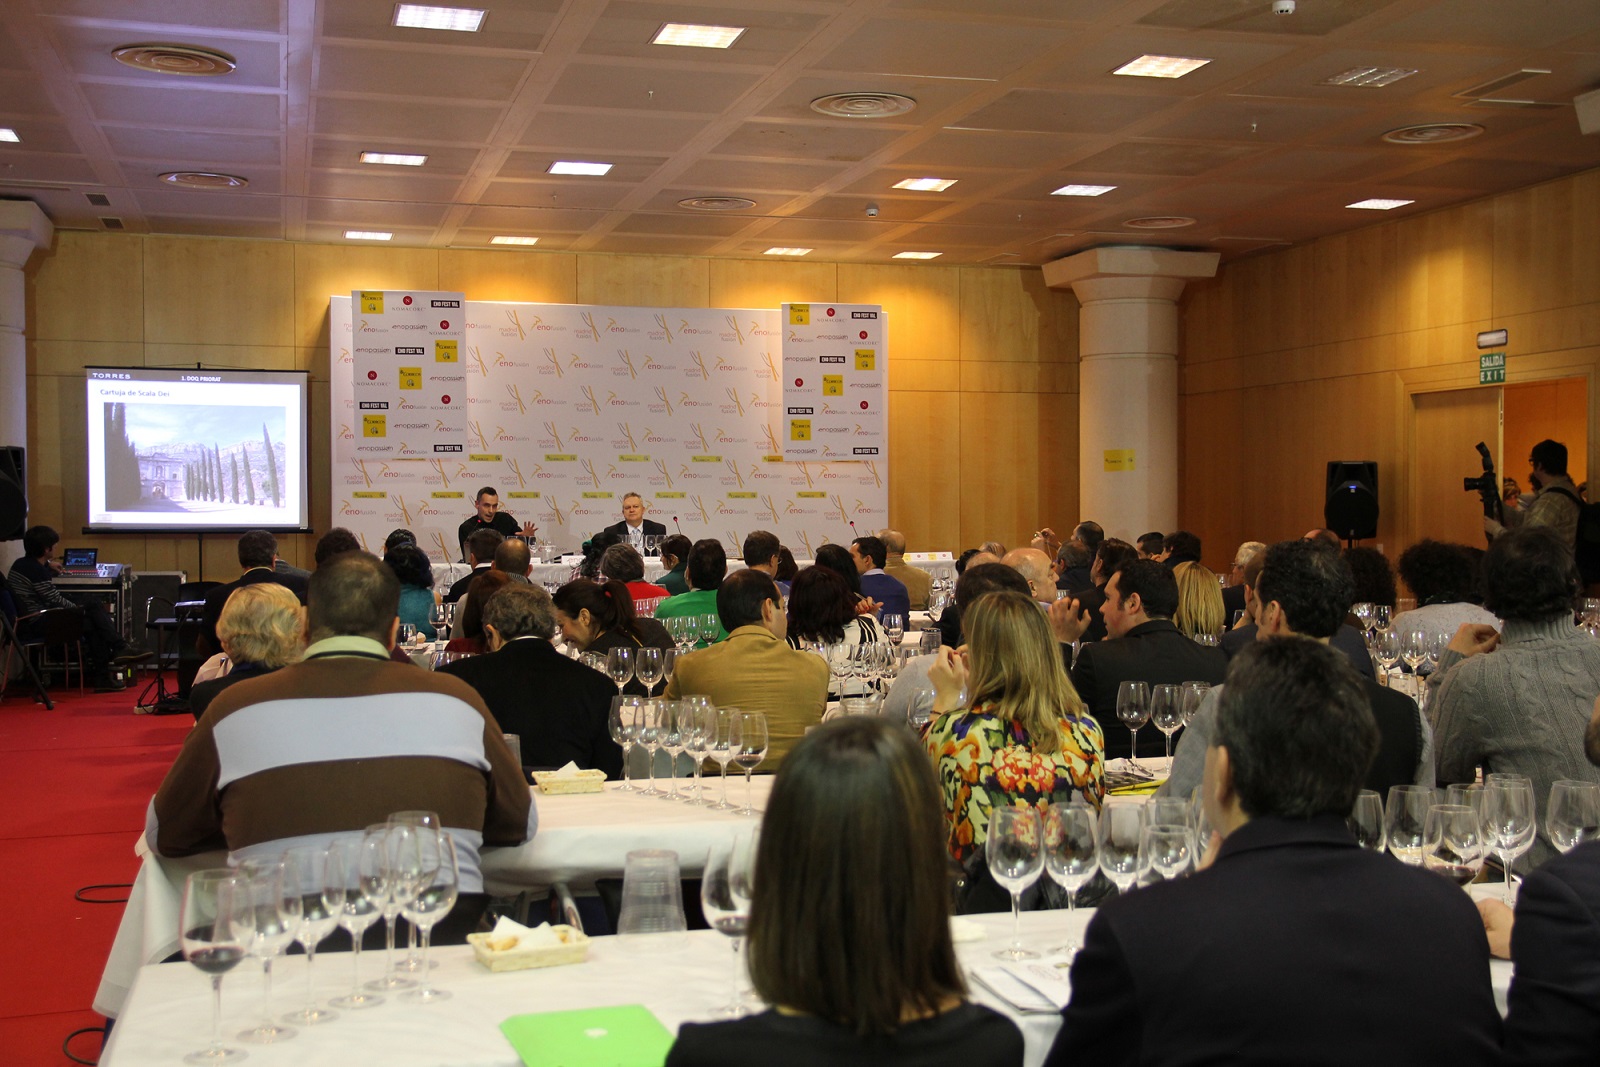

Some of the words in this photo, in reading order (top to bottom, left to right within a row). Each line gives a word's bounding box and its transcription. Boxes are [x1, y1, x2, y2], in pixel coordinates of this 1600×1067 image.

[1481, 355, 1504, 367] SALIDA
[1480, 370, 1504, 381] EXIT
[100, 389, 125, 397] Cartuja
